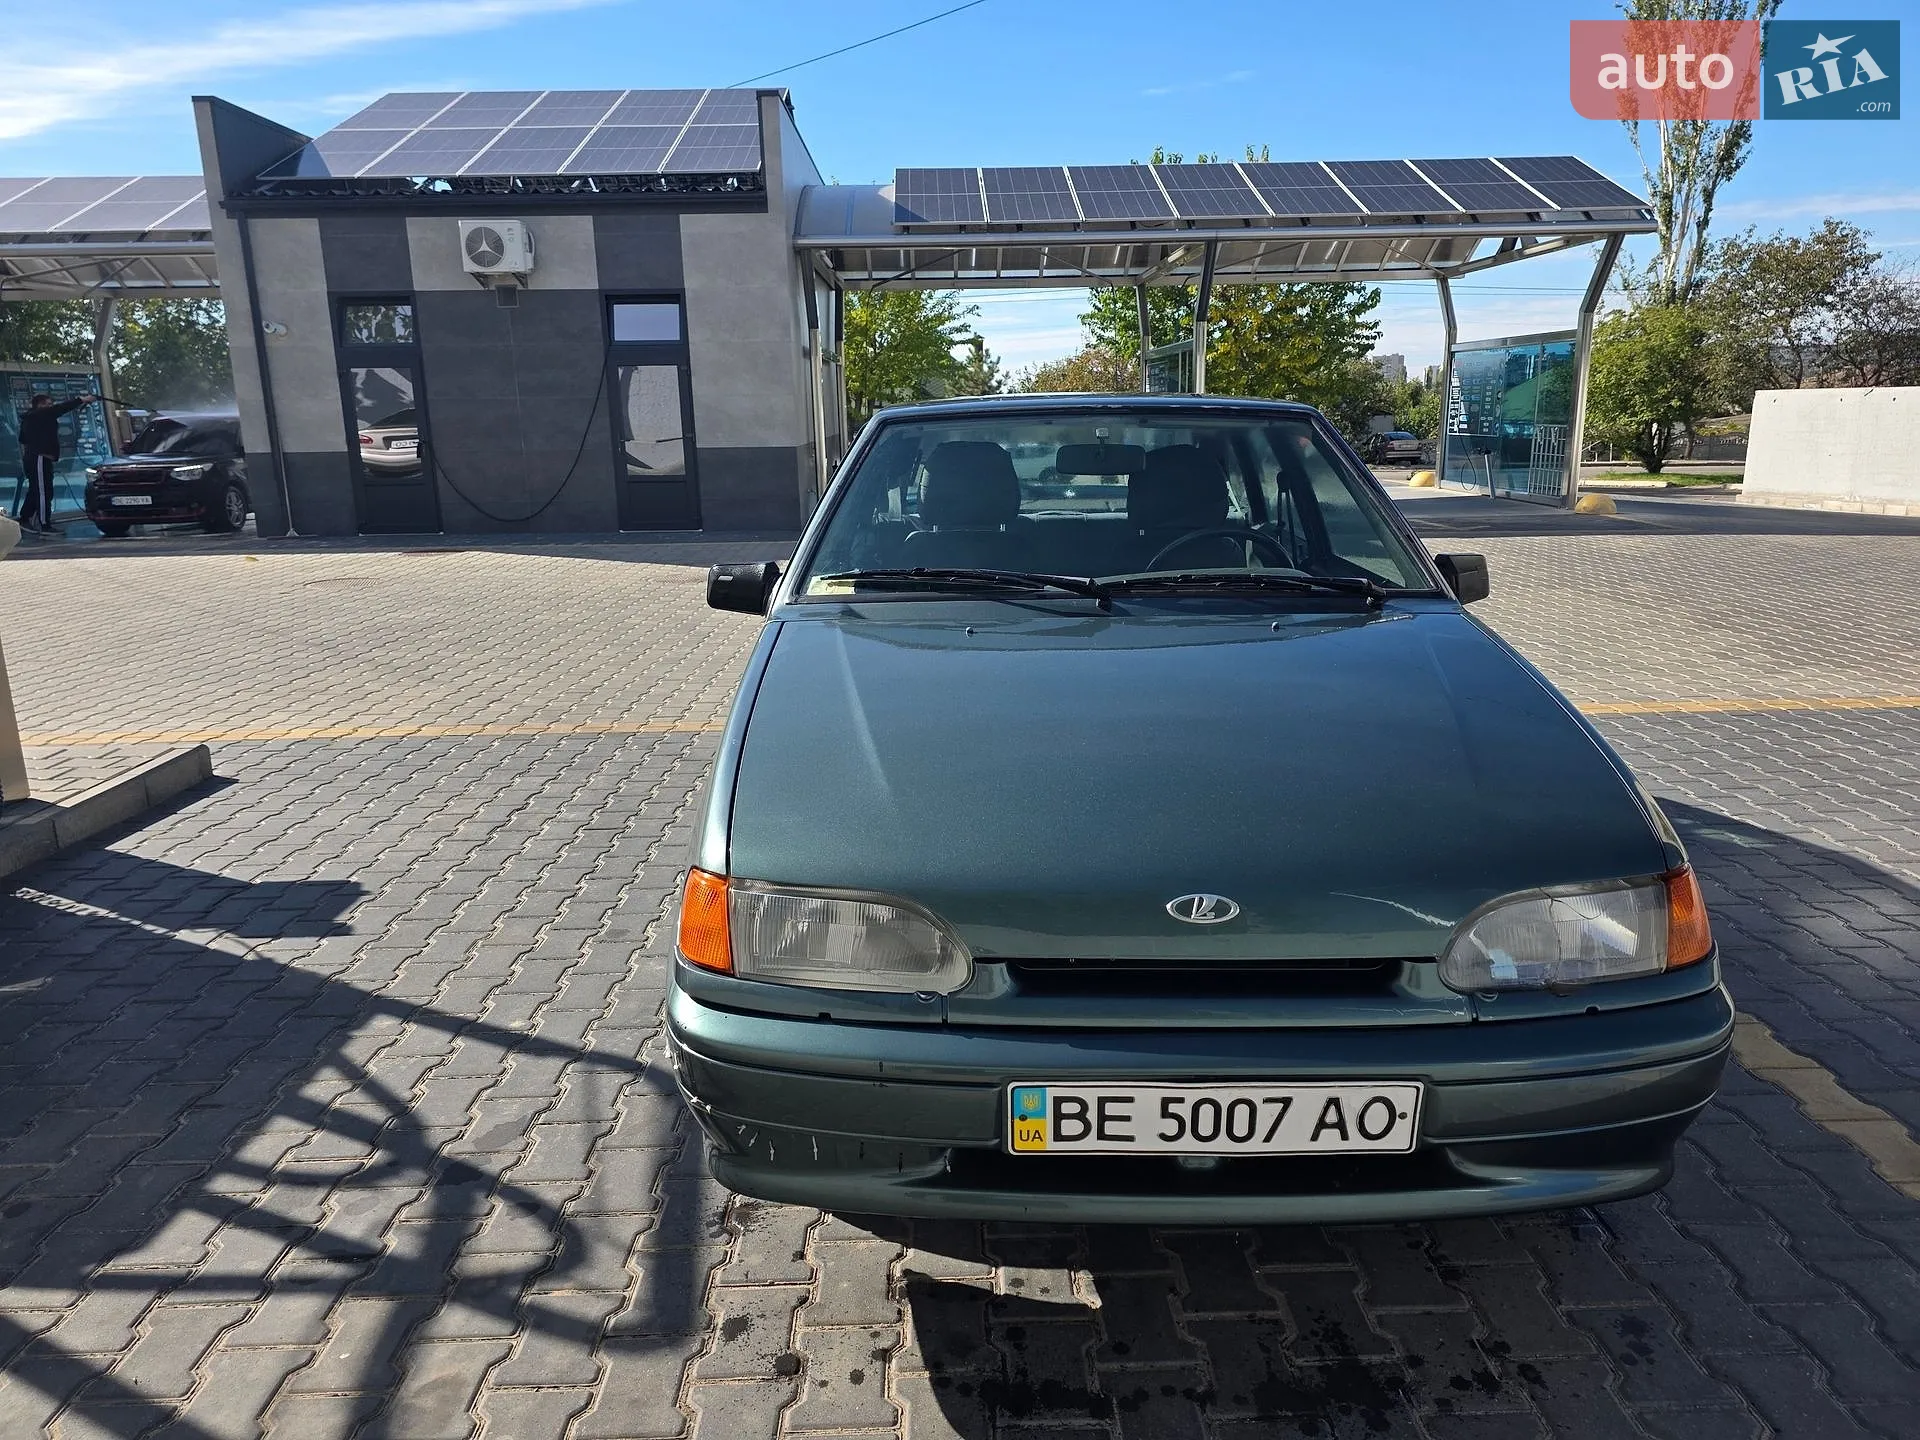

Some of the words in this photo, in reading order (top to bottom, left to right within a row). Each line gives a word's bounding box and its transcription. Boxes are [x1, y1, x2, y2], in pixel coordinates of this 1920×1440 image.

[1052, 1095, 1136, 1143] BE
[1157, 1096, 1294, 1144] 5007
[1309, 1095, 1397, 1142] AO
[1019, 1129, 1044, 1143] UA
